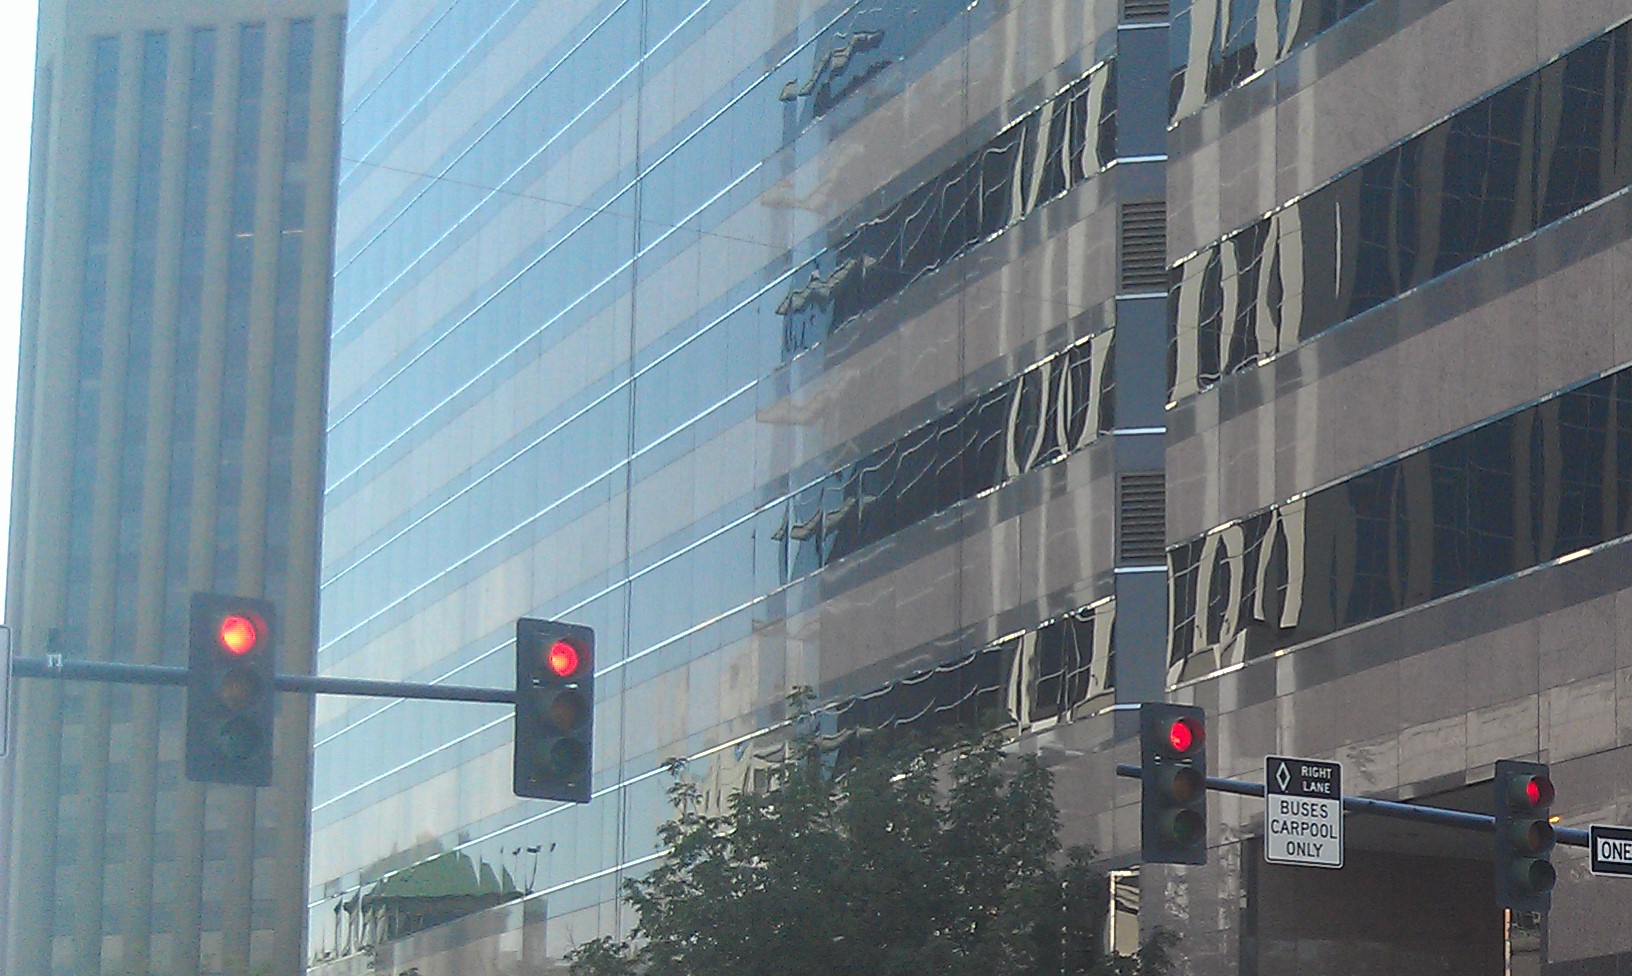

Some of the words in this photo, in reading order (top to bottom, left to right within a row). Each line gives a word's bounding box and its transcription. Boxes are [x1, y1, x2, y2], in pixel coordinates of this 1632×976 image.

[1301, 766, 1332, 779] RIGHT
[1303, 781, 1331, 794] LANE
[1280, 800, 1328, 819] BUSES
[1270, 819, 1338, 839] CARPOOL
[1286, 841, 1323, 858] ONLY
[1601, 841, 1632, 861] ONE
